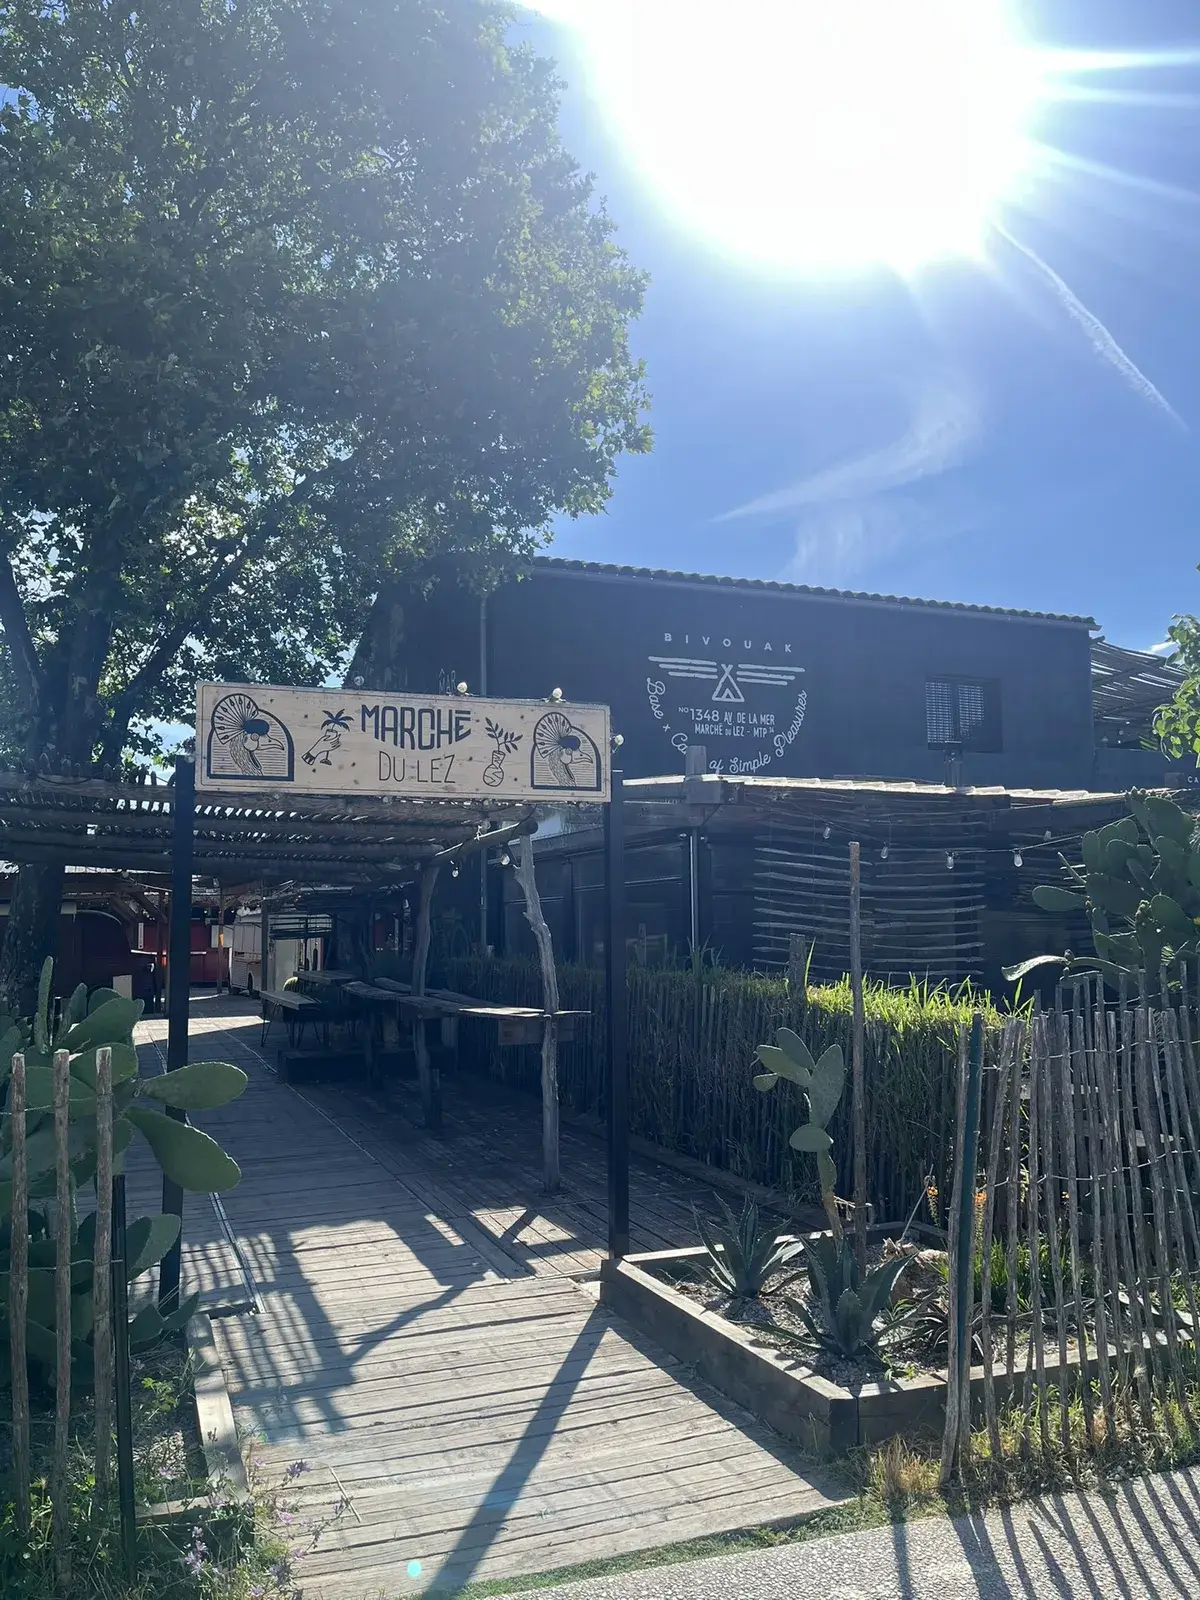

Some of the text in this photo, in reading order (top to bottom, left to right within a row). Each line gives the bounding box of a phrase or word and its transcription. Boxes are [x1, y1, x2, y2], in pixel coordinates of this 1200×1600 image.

[664, 632, 792, 653] BIVOUAK
[646, 677, 666, 720] Base
[729, 751, 772, 774] Simple
[773, 689, 808, 758] Pleasures
[690, 708, 720, 722] 1348
[736, 712, 746, 724] DE
[748, 713, 758, 725] LA
[759, 713, 775, 726] MER
[732, 725, 745, 737] LEZ
[753, 727, 768, 738] MTP
[379, 750, 456, 784] DU LEZ
